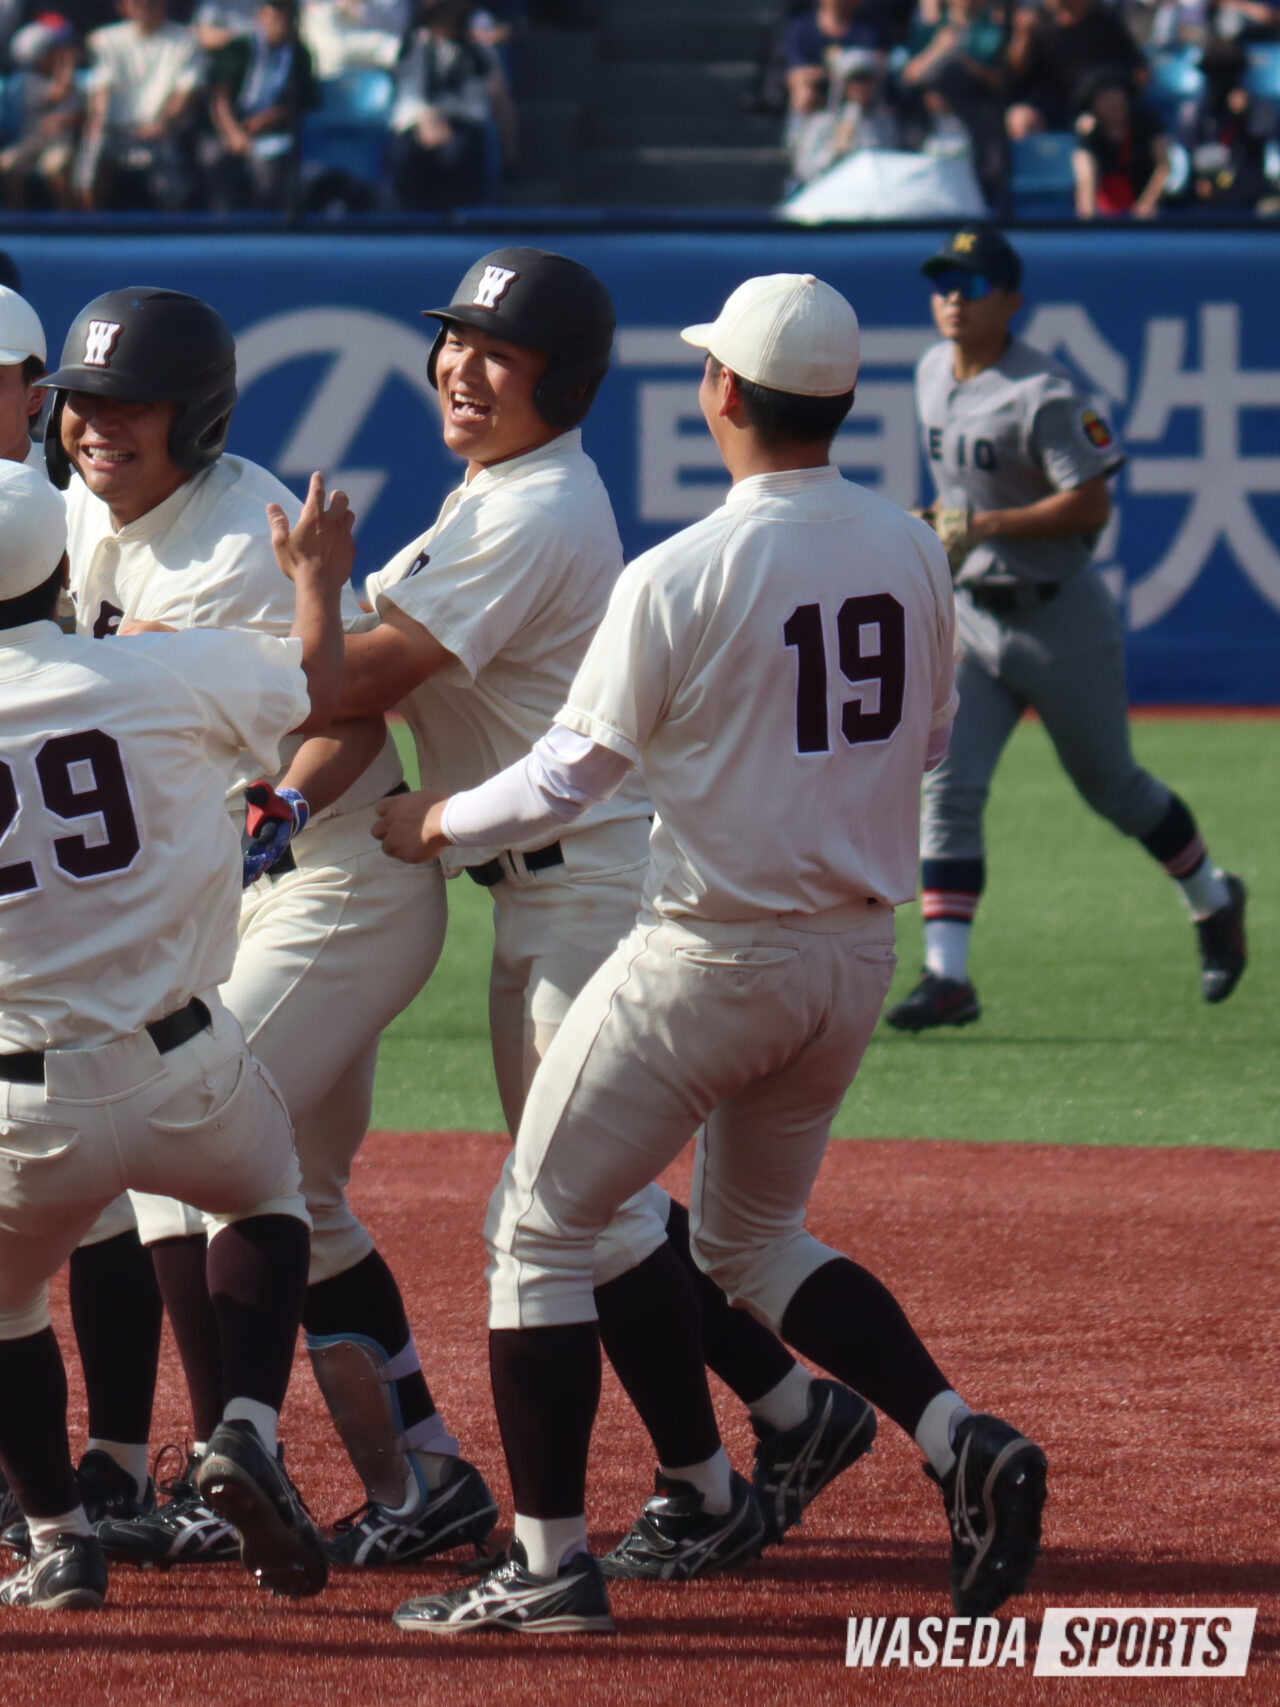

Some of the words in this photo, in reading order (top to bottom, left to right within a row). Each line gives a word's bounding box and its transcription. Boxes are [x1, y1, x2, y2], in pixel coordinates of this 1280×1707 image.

[472, 264, 519, 312] W
[83, 319, 123, 368] W
[782, 591, 908, 756] 19
